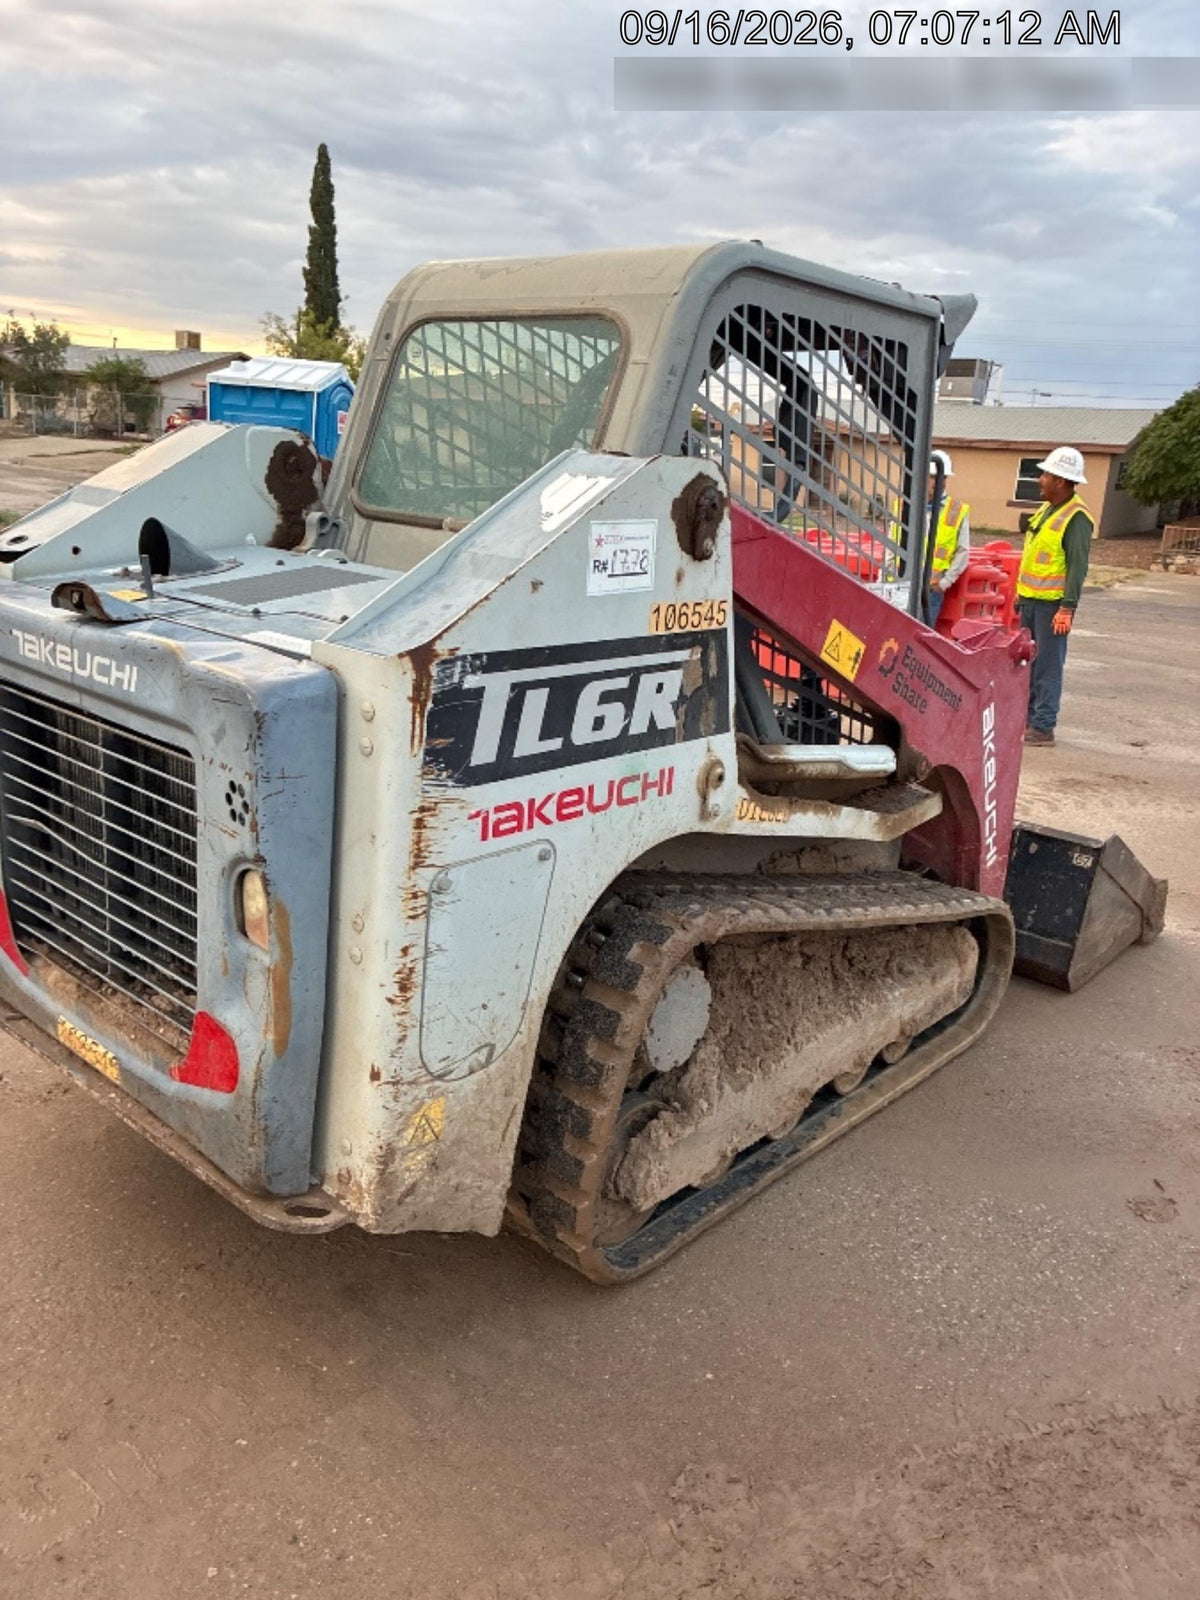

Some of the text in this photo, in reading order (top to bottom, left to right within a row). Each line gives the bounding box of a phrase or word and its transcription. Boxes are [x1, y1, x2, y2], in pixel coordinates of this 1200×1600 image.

[652, 600, 728, 632] 106545
[892, 672, 927, 714] Share
[901, 644, 962, 712] Equipment
[463, 649, 693, 767] TL6R
